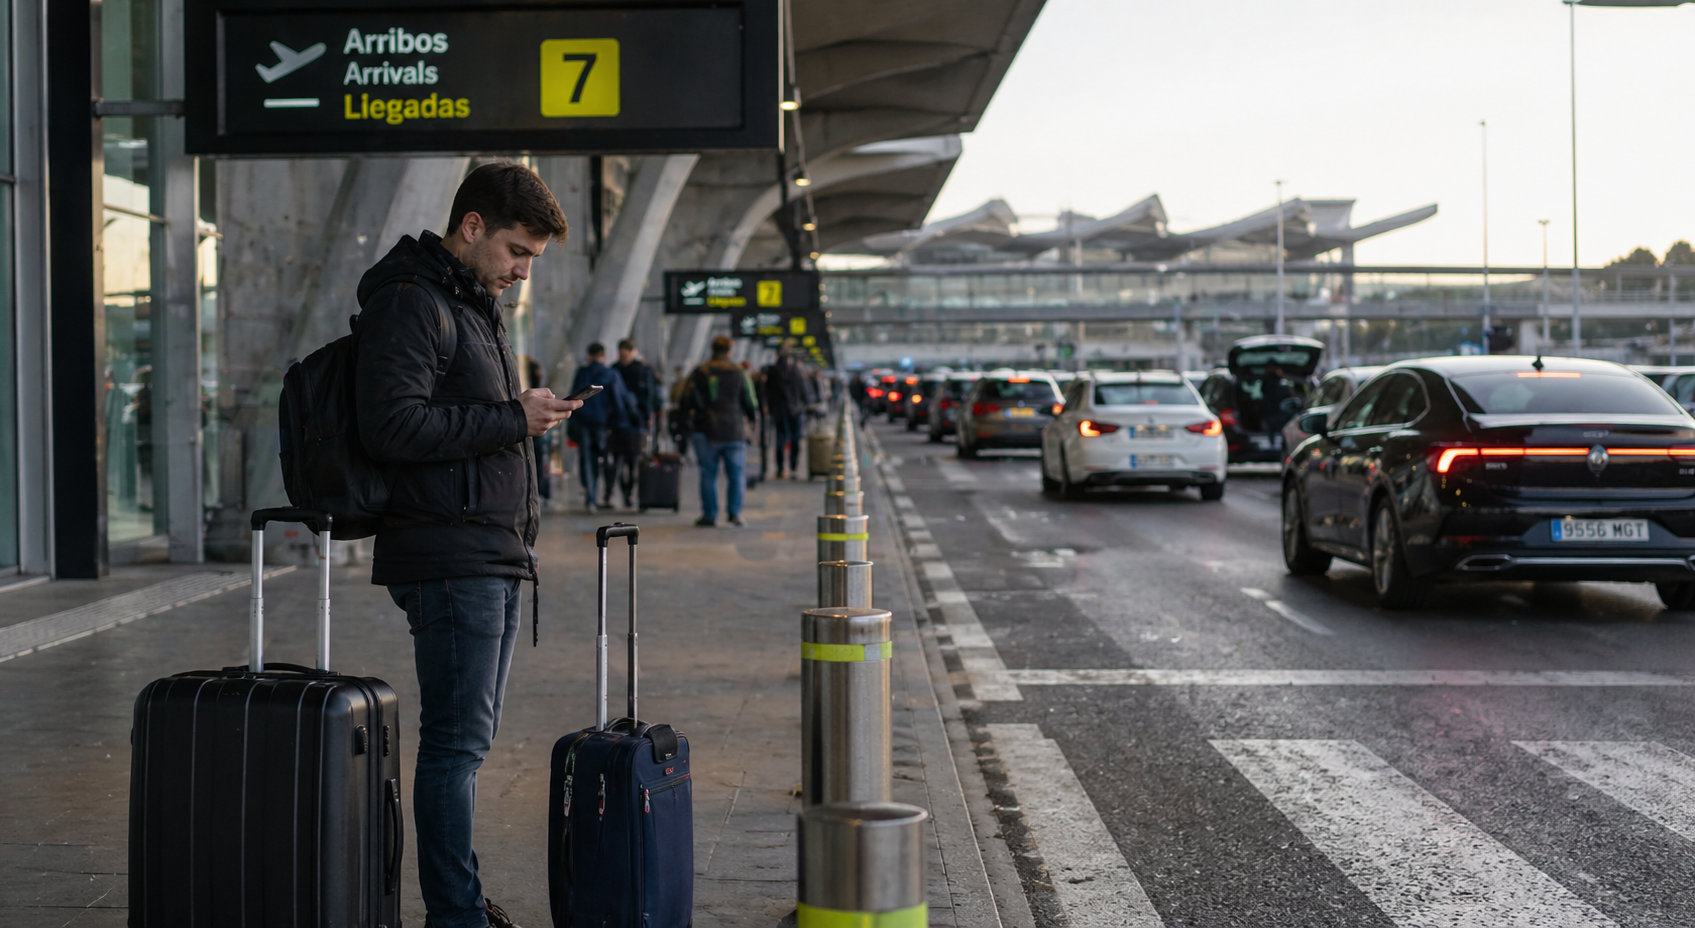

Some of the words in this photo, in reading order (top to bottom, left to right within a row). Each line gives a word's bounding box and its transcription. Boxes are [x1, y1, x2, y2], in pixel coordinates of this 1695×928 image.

[343, 27, 448, 54] Arribos
[343, 60, 439, 85] Arrivals
[562, 52, 598, 104] 7
[1563, 522, 1607, 537] 9556
[1612, 522, 1644, 537] MGT
